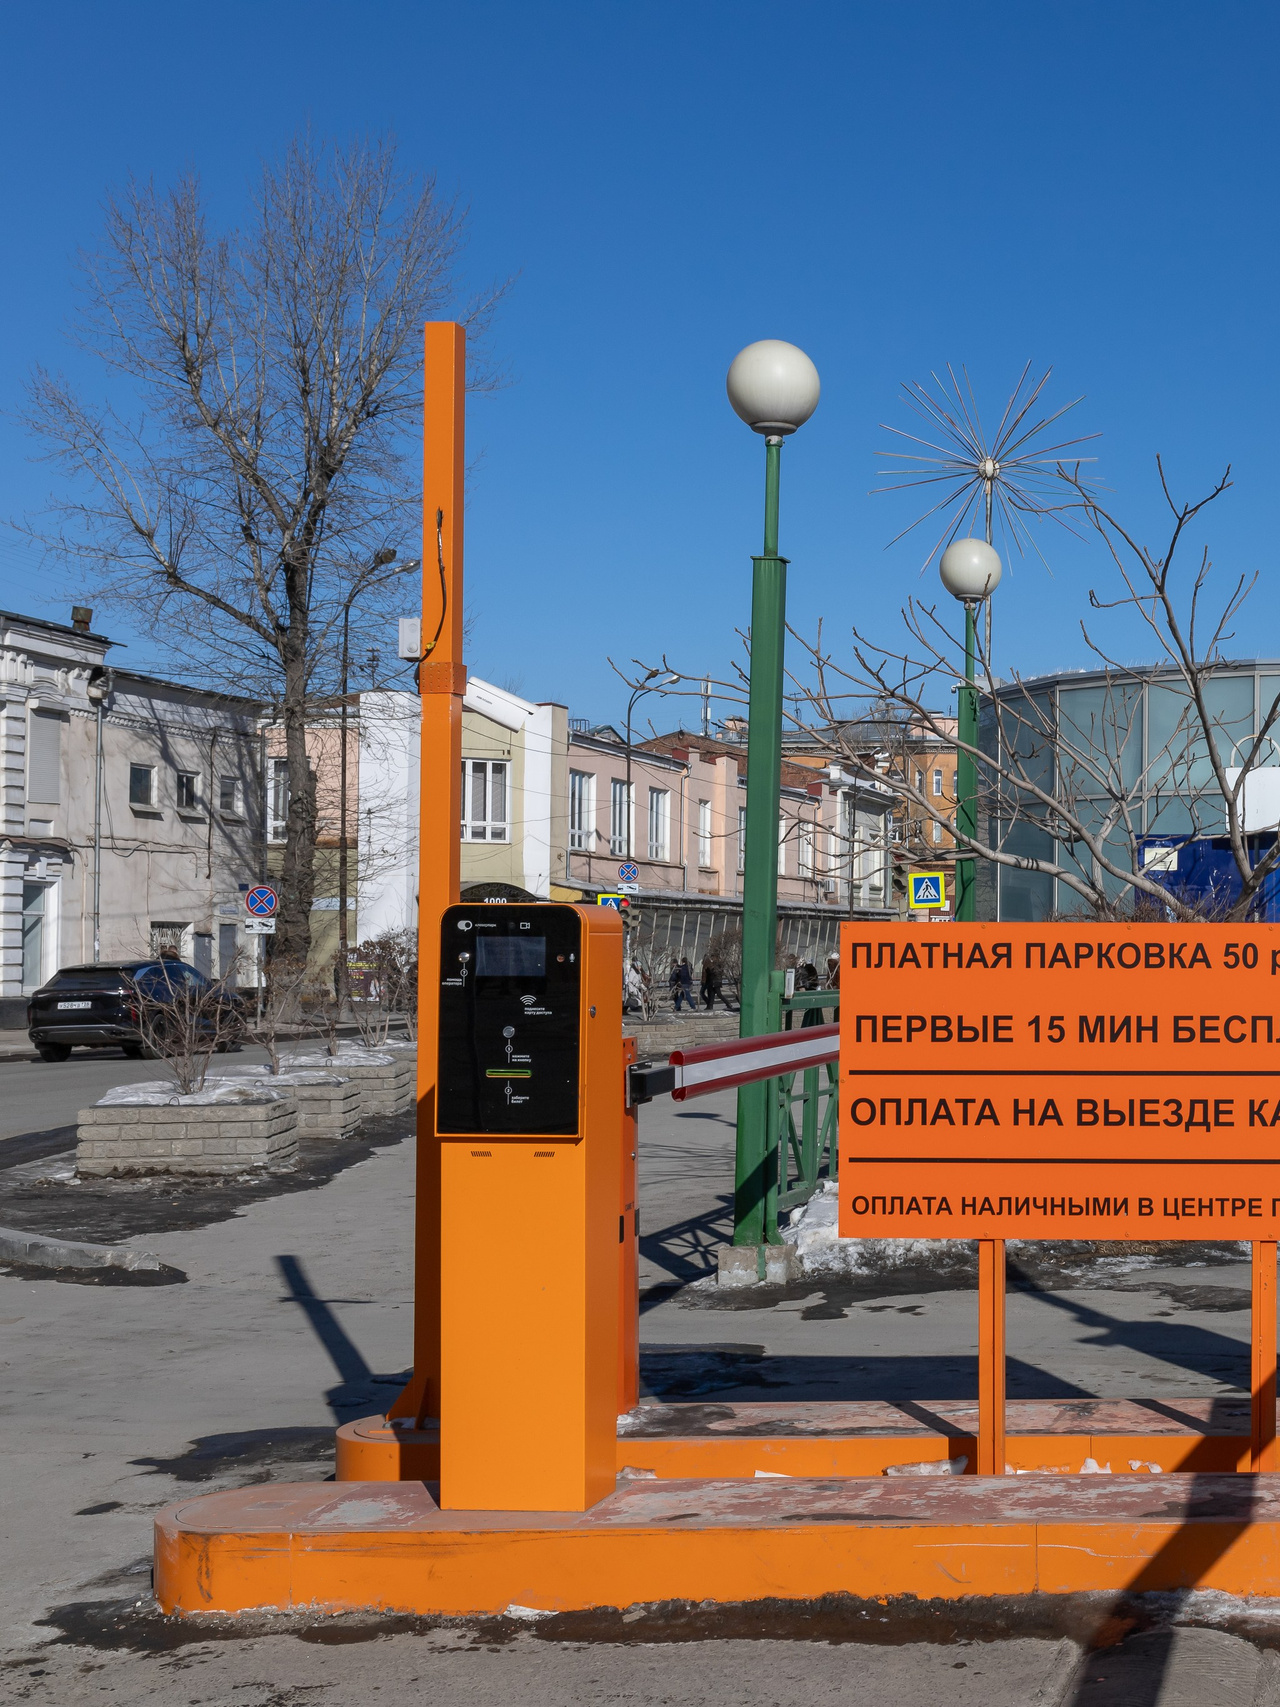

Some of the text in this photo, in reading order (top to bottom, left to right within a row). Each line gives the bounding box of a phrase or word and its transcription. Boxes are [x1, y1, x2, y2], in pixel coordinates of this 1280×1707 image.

[851, 942, 1012, 969] ПЛАТНАЯ
[1025, 942, 1212, 969] ПАРКОВКА
[1223, 942, 1259, 970] 50
[855, 1015, 1014, 1043] ПЕРВЫЕ
[1028, 1015, 1066, 1044] 15
[1078, 1015, 1158, 1043] МИН
[850, 1097, 1001, 1126] ОПЛАТА
[1013, 1098, 1064, 1127] НА
[1076, 1098, 1235, 1133] ВЫЕЗДЕ
[852, 1195, 953, 1216] ОПЛАТА
[961, 1196, 1129, 1217] НАЛИЧНЫМИ
[1138, 1197, 1154, 1217] В
[1163, 1197, 1263, 1221] ЦЕНТРЕ
